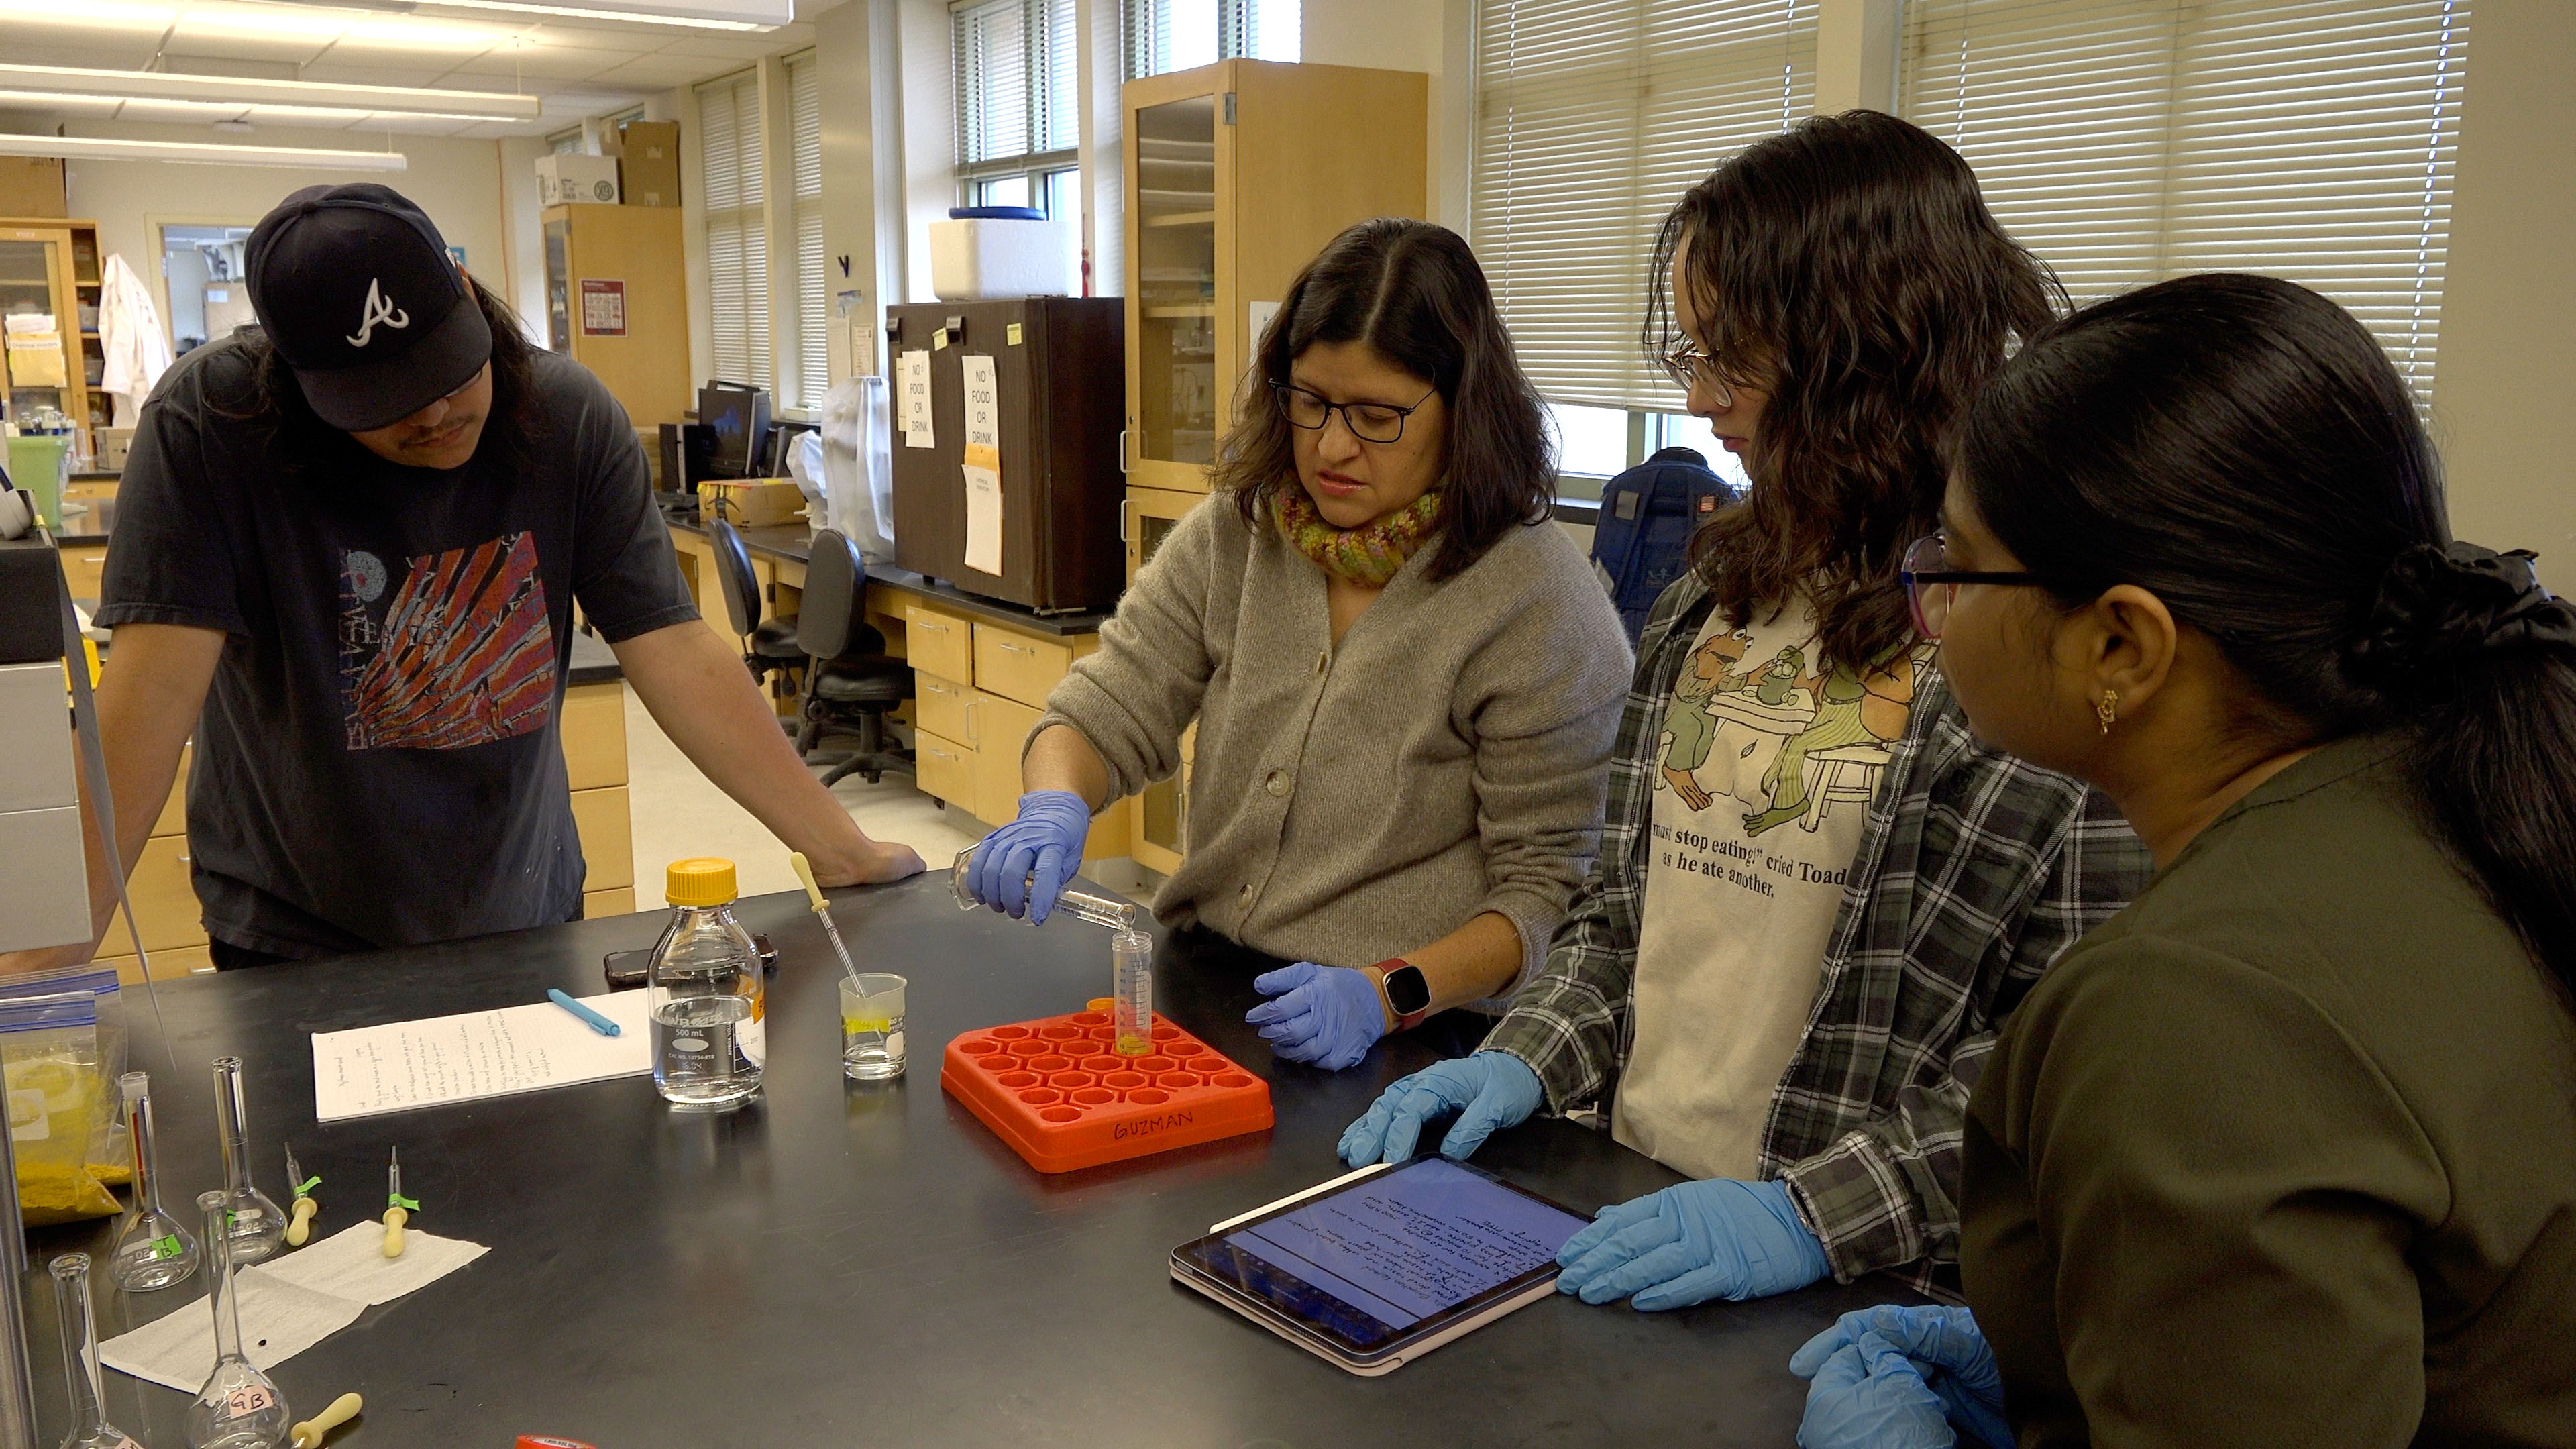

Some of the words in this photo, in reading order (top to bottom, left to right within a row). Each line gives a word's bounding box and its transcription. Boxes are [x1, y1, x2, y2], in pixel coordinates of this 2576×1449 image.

[913, 365, 920, 376] NO
[975, 370, 986, 382] NO
[910, 383, 924, 394] FOOD
[972, 390, 991, 404] FOOD
[914, 402, 922, 413] OR
[977, 411, 987, 424] OR
[912, 421, 928, 433] DRINK
[972, 431, 993, 445] DRINK
[1653, 824, 1672, 841] must
[1675, 830, 1708, 853] stop
[1766, 855, 1794, 878] cried
[1799, 862, 1847, 885] Toad
[1663, 852, 1672, 867] as
[1676, 852, 1697, 872] he
[1702, 861, 1723, 879] ate
[1729, 869, 1774, 898] another.
[1114, 1112, 1193, 1140] GUZMAN
[230, 1393, 264, 1409] GB
